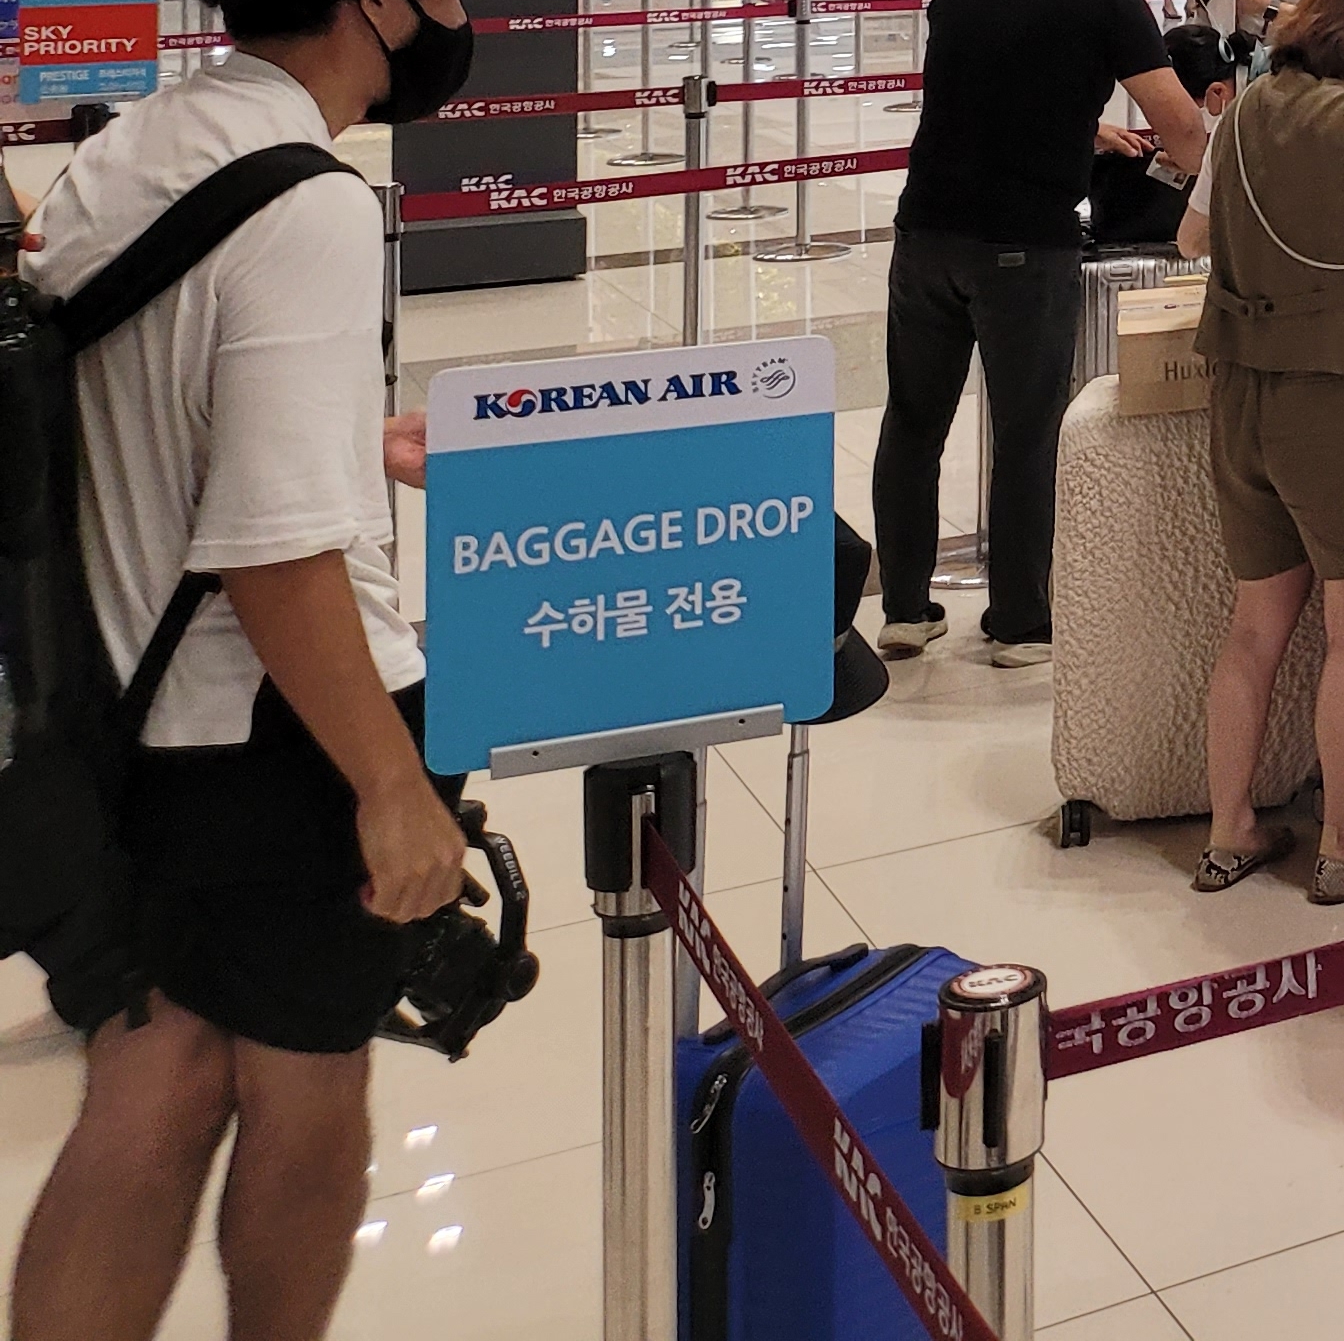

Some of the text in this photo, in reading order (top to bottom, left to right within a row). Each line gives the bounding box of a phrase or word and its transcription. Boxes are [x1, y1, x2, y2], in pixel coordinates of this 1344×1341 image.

[509, 17, 543, 29] KAC
[646, 11, 680, 22] KAC
[24, 25, 73, 40] SKY
[24, 38, 137, 56] PRIORITY
[635, 88, 680, 105] KAC
[803, 80, 845, 95] KAC
[438, 101, 486, 119] KAC
[461, 174, 514, 192] KAC
[725, 163, 779, 185] KAC
[489, 187, 548, 209] KAC
[473, 370, 742, 421] KOREAN AIR
[453, 495, 814, 574] BAGGAGE DROP
[523, 578, 748, 648] 수하물 전용
[678, 881, 713, 977] KAC
[833, 1117, 883, 1241] KAC
